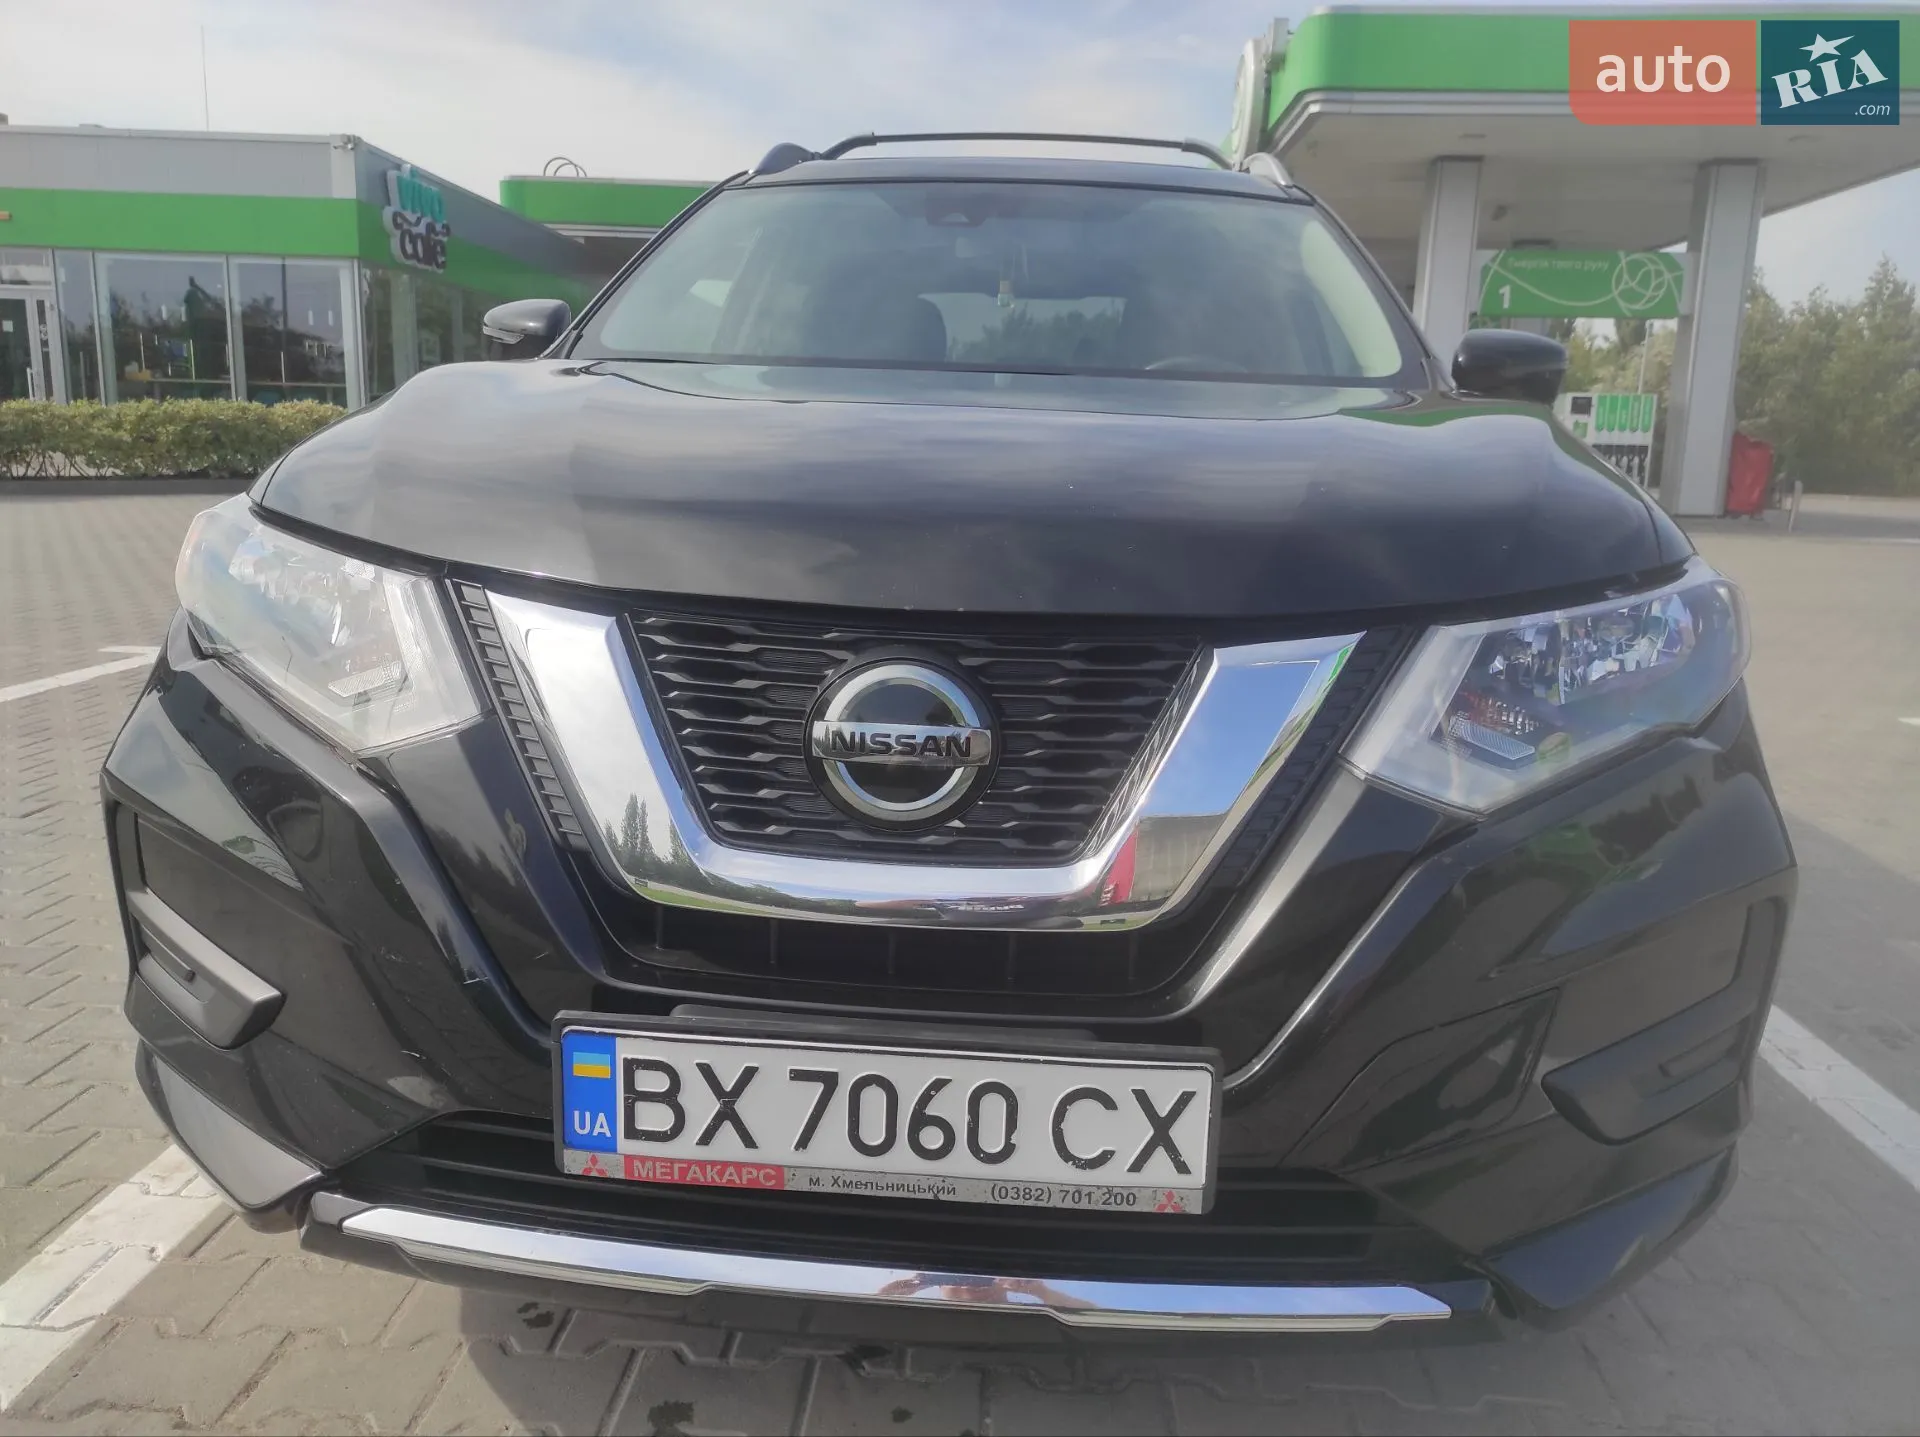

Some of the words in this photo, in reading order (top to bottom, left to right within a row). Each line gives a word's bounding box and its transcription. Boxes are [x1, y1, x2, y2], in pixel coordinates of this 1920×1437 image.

[1499, 285, 1511, 309] 1
[831, 730, 971, 758] NISSAN
[573, 1110, 611, 1138] UA
[622, 1056, 760, 1150] BX
[788, 1067, 1019, 1165] 7060
[1051, 1086, 1197, 1175] CX
[632, 1159, 777, 1186] МЕГАКАРС
[808, 1176, 825, 1187] м.
[830, 1174, 957, 1196] Хмельницький
[990, 1184, 1053, 1204] (0382)
[1059, 1189, 1093, 1205] 701
[1101, 1190, 1137, 1206] 200
